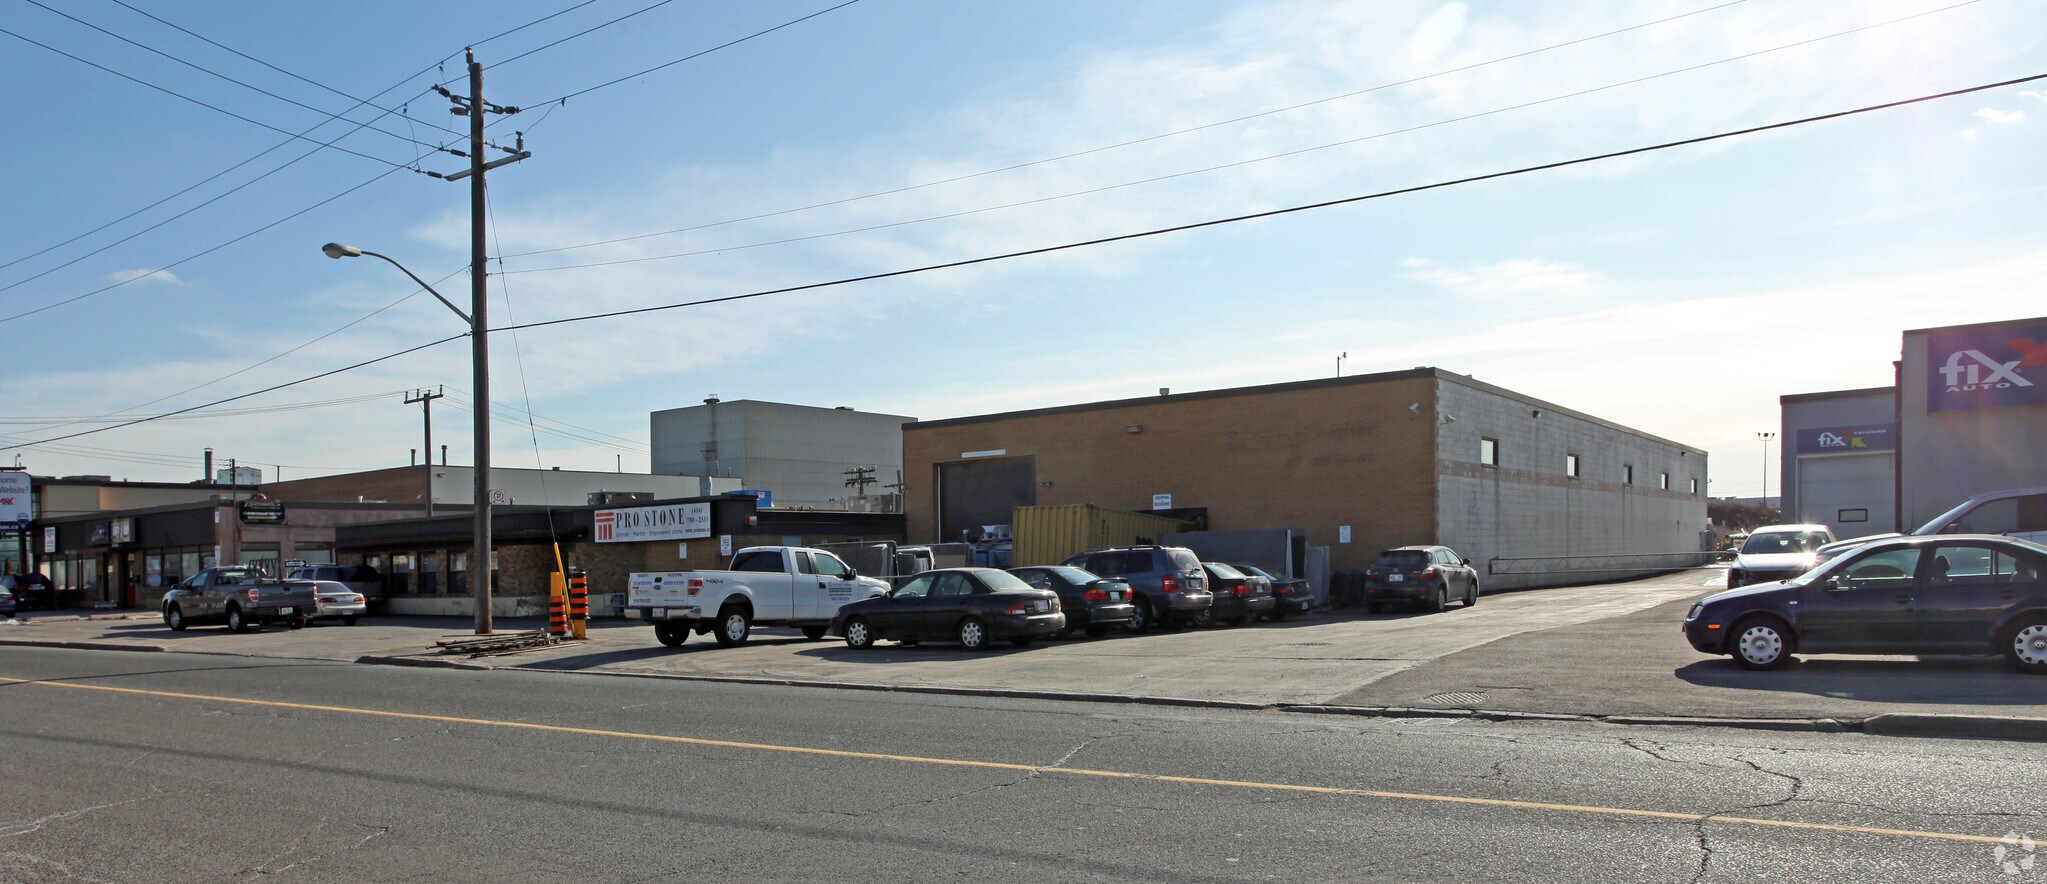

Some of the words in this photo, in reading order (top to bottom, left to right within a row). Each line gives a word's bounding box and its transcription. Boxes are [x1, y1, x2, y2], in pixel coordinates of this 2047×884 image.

[1939, 349, 2035, 387] fix
[1945, 382, 2011, 393] AUTO
[1818, 432, 1847, 447] fix
[616, 512, 640, 528] PRO
[644, 507, 685, 528] STONE
